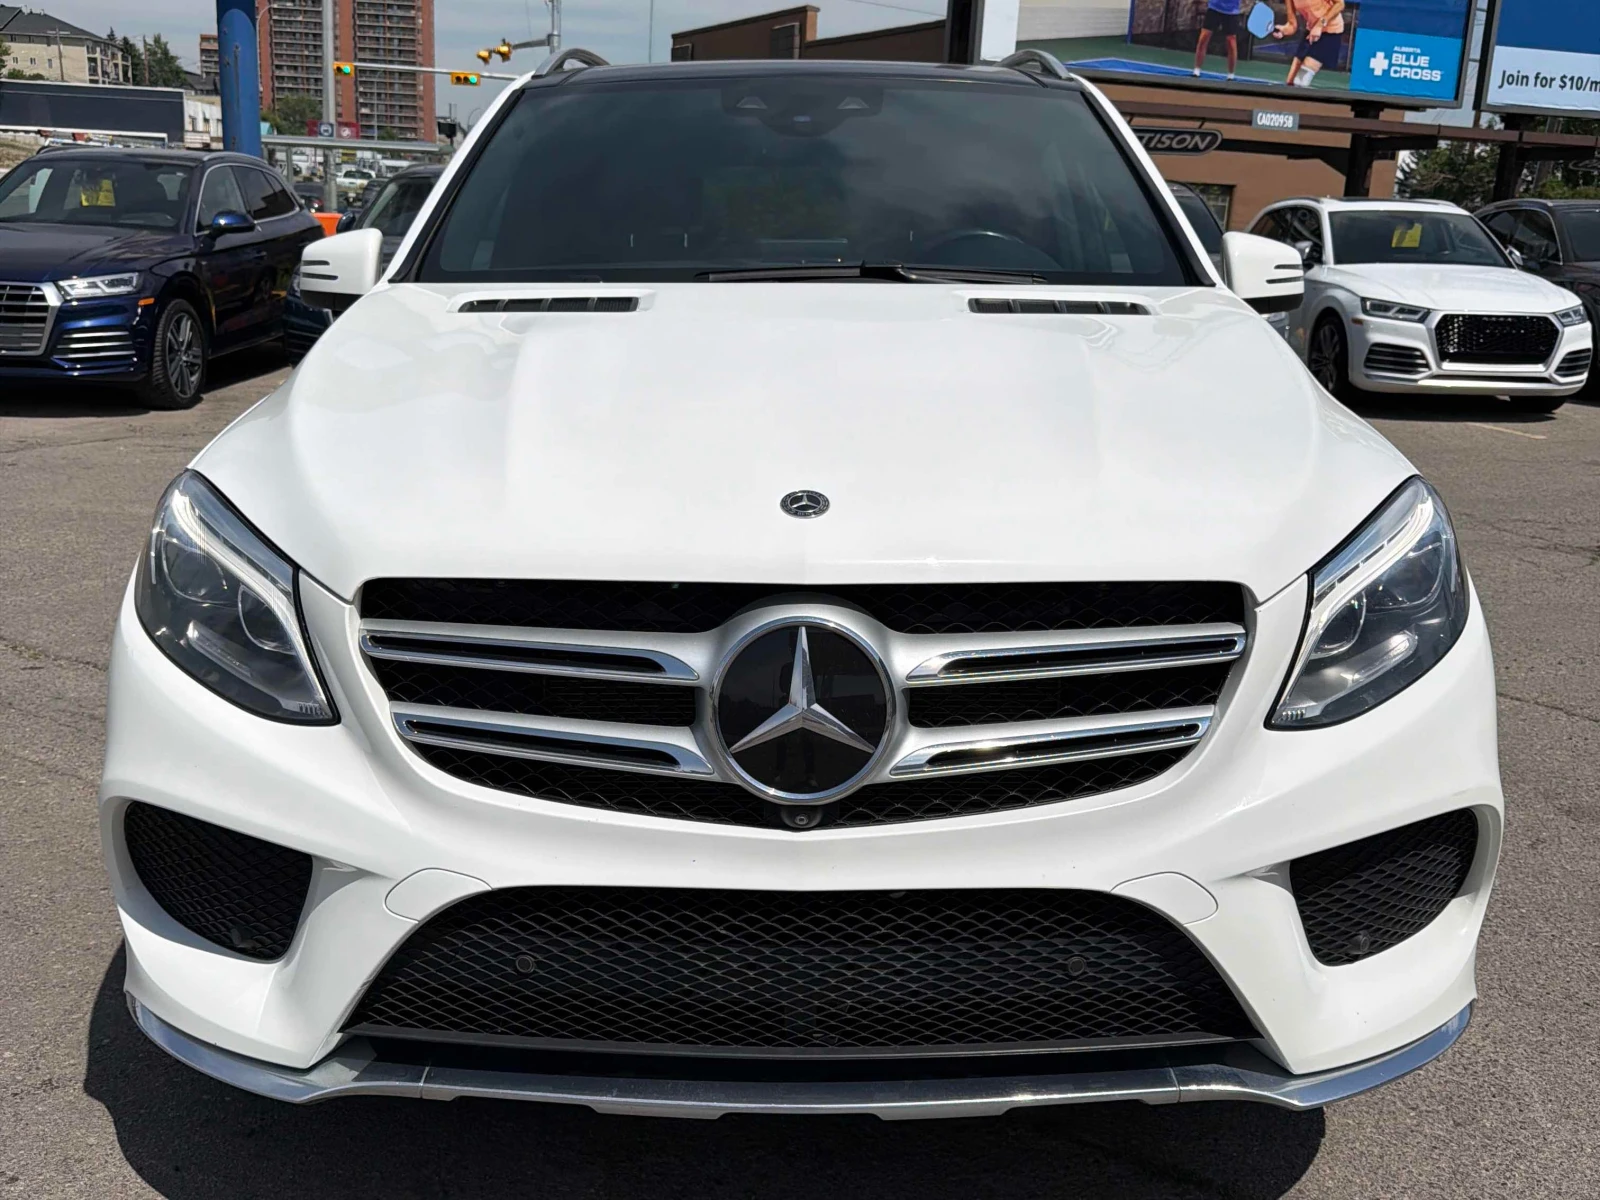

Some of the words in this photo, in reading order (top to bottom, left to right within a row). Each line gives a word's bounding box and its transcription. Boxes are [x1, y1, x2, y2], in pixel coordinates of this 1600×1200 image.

[1391, 52, 1430, 67] BLUE
[1390, 66, 1441, 81] CROSS
[1498, 70, 1529, 89] Join
[1533, 72, 1556, 88] for
[1136, 133, 1212, 150] TISON
